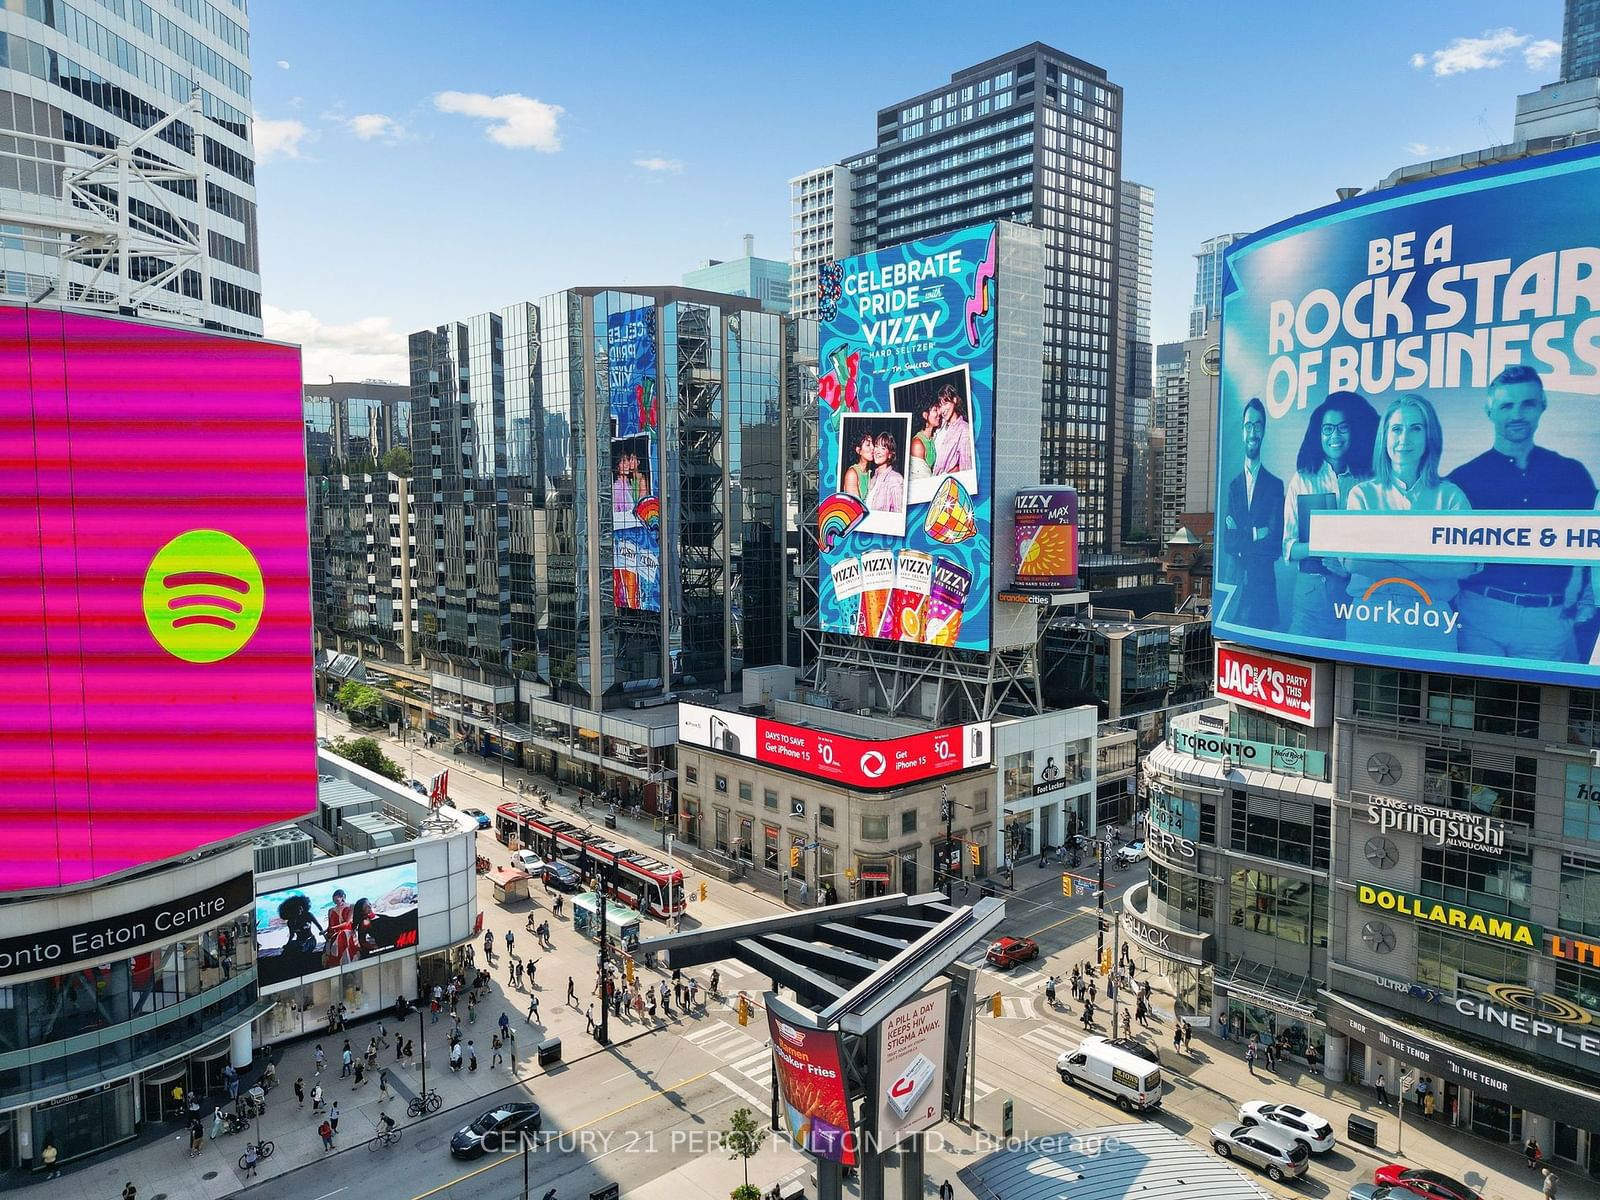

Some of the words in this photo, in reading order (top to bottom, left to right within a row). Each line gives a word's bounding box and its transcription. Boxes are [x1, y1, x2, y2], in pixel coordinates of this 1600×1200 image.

[1367, 231, 1417, 276] BE
[1424, 224, 1453, 266] A
[844, 249, 962, 295] CELEBRATE
[859, 286, 920, 318] PRIDE
[1267, 269, 1417, 355] ROCK
[1425, 245, 1600, 331] STAR
[861, 310, 941, 347] VIZZY
[869, 349, 892, 359] HARD
[895, 342, 935, 355] SELTZER
[1265, 349, 1323, 419] OF
[1328, 316, 1600, 396] BUSINESS
[1048, 504, 1069, 520] MAX
[1430, 526, 1532, 547] FINANCE
[1538, 527, 1557, 547] &
[1565, 528, 1600, 548] HR
[832, 564, 859, 583] VIZZY
[862, 557, 893, 572] VIZZY
[900, 558, 932, 576] VIZZY
[935, 567, 970, 593] VIZZY
[1333, 599, 1460, 635] workday
[1219, 659, 1285, 705] JACK'S
[1285, 673, 1308, 688] PARTY
[1285, 685, 1303, 698] THIS
[1285, 697, 1302, 709] WAY
[765, 730, 782, 742] DAYS
[781, 733, 791, 744] TO
[790, 735, 805, 747] SAVE
[765, 742, 778, 753] Get
[778, 744, 801, 758] iPhone
[801, 751, 811, 761] 15
[1181, 733, 1257, 759] TORONTO
[895, 750, 909, 761] Get
[895, 759, 918, 771] iPhone
[918, 756, 927, 766] 15
[1036, 784, 1049, 795] Foot
[1048, 780, 1065, 792] Locker
[1368, 795, 1408, 811] LOUNGE
[1413, 804, 1482, 825] RESTAURANT
[72, 923, 146, 955] Eaton
[154, 896, 225, 932] Centre
[1359, 886, 1534, 946] DOLLARAMA
[1376, 976, 1409, 994] ULTRA
[887, 1022, 911, 1041] KEEPS
[912, 1015, 926, 1029] HIV
[888, 1020, 894, 1030] A
[895, 1012, 911, 1026] PILL
[912, 1009, 919, 1019] A
[920, 1001, 935, 1016] DAY
[1456, 998, 1600, 1057] CINEPLE
[887, 1031, 916, 1051] STIGMA
[917, 1019, 941, 1037] AWAY.
[778, 1037, 810, 1063] Ramen
[1391, 1039, 1406, 1052] THE
[1407, 1045, 1430, 1063] TENOR
[807, 1065, 837, 1080] Fries
[1461, 1067, 1478, 1082] THE
[1479, 1075, 1509, 1093] TENOR
